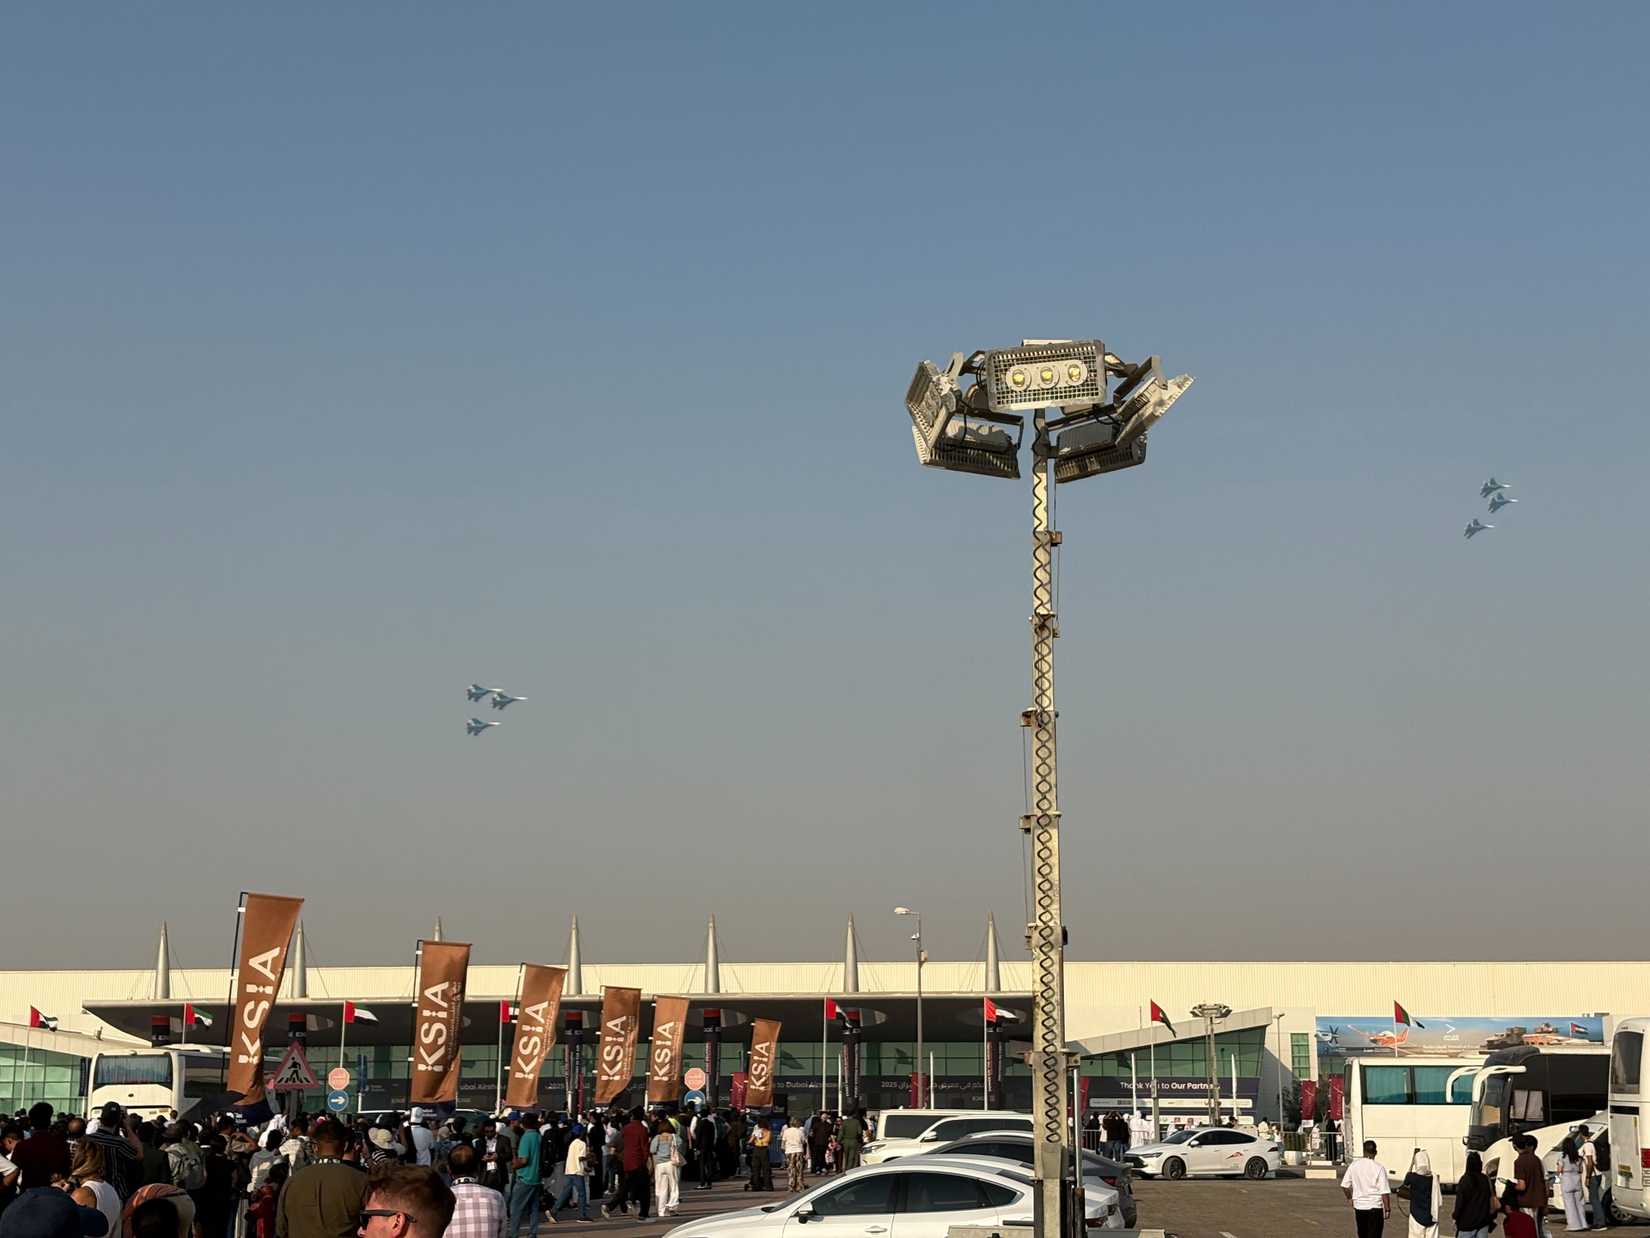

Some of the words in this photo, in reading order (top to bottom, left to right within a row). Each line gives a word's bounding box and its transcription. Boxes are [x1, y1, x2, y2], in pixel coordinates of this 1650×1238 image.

[417, 981, 449, 1072] KSIA
[514, 1000, 549, 1080] KSIA
[601, 1015, 626, 1080] KSIA
[653, 1021, 674, 1081] KSIA
[750, 1041, 770, 1090] KSIA
[1161, 1081, 1170, 1089] to
[1187, 1082, 1220, 1090] Partne
